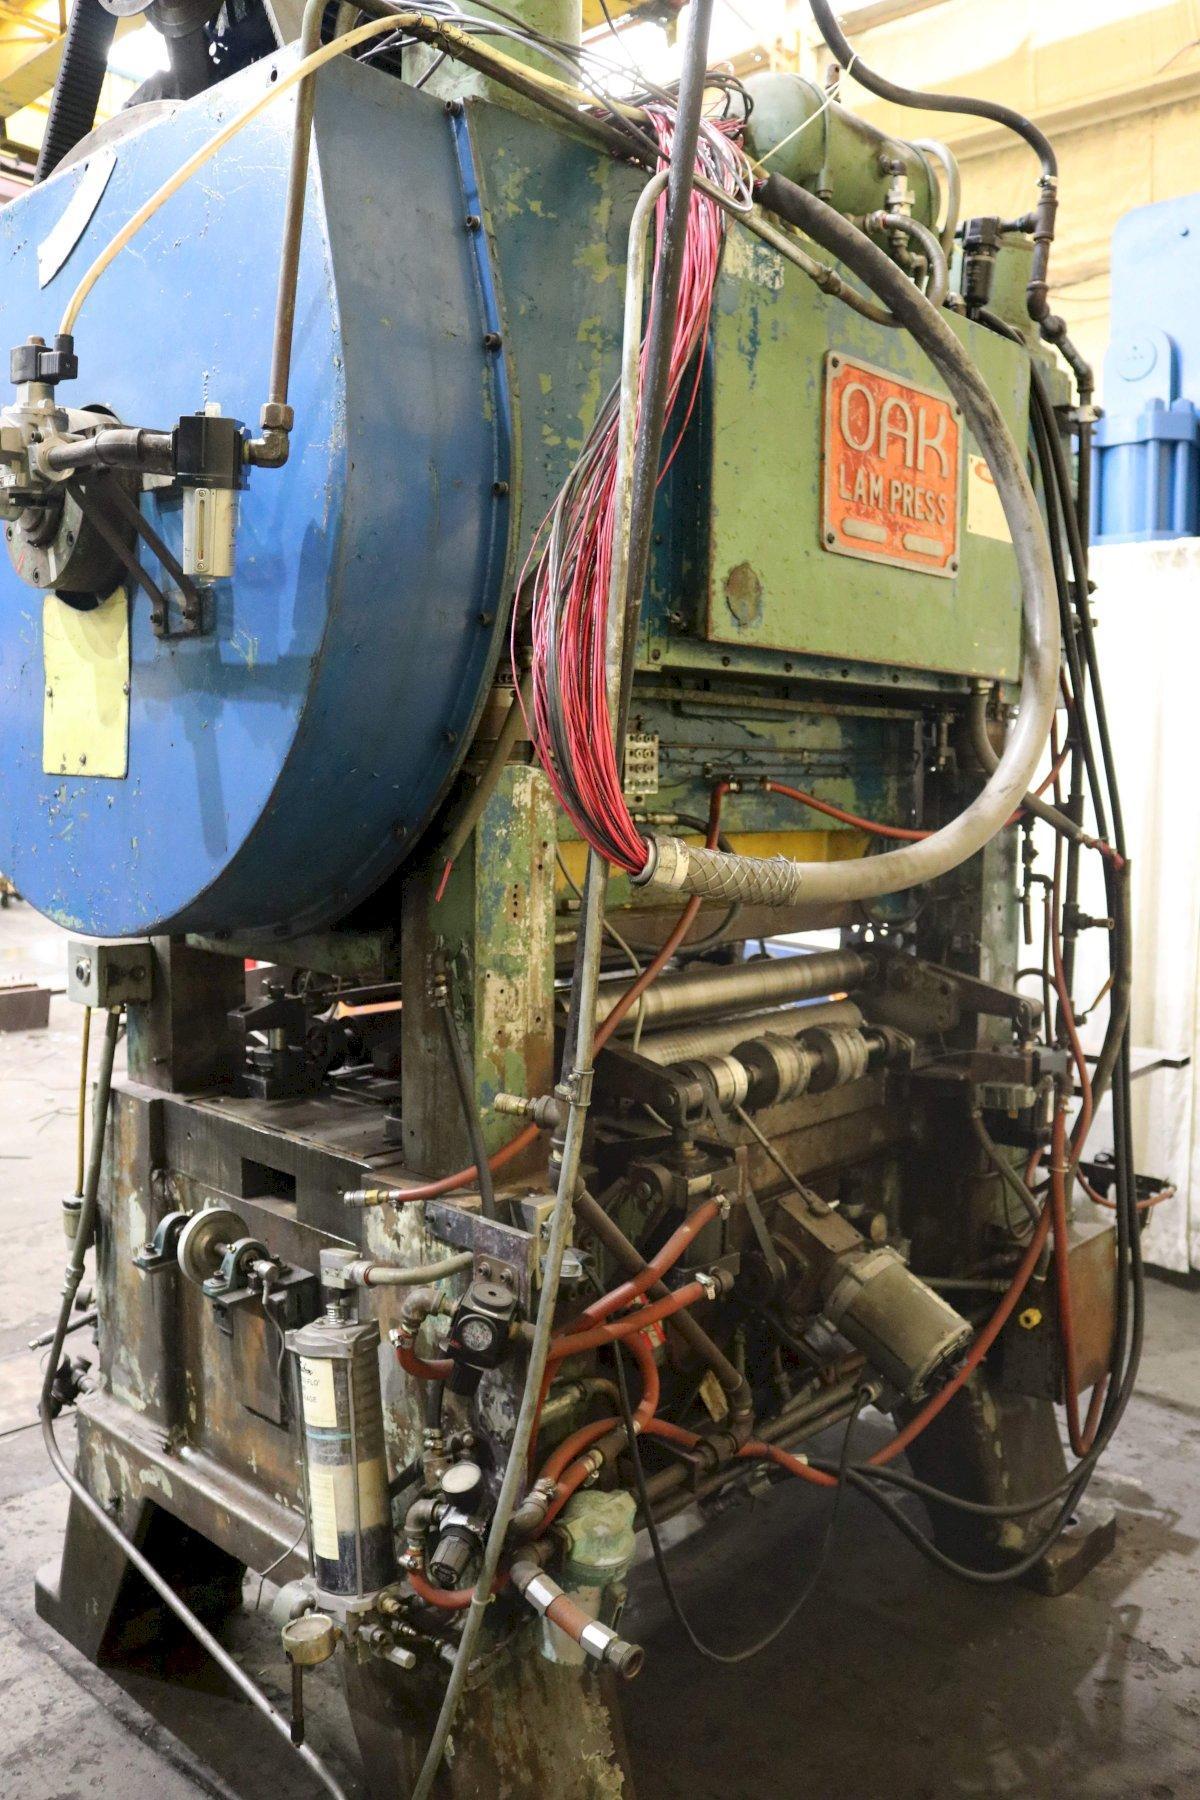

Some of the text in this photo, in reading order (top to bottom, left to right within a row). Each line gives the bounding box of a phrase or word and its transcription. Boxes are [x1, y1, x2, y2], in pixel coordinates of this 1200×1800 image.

[839, 381, 949, 479] OAK
[838, 463, 947, 526] LAM PRESS
